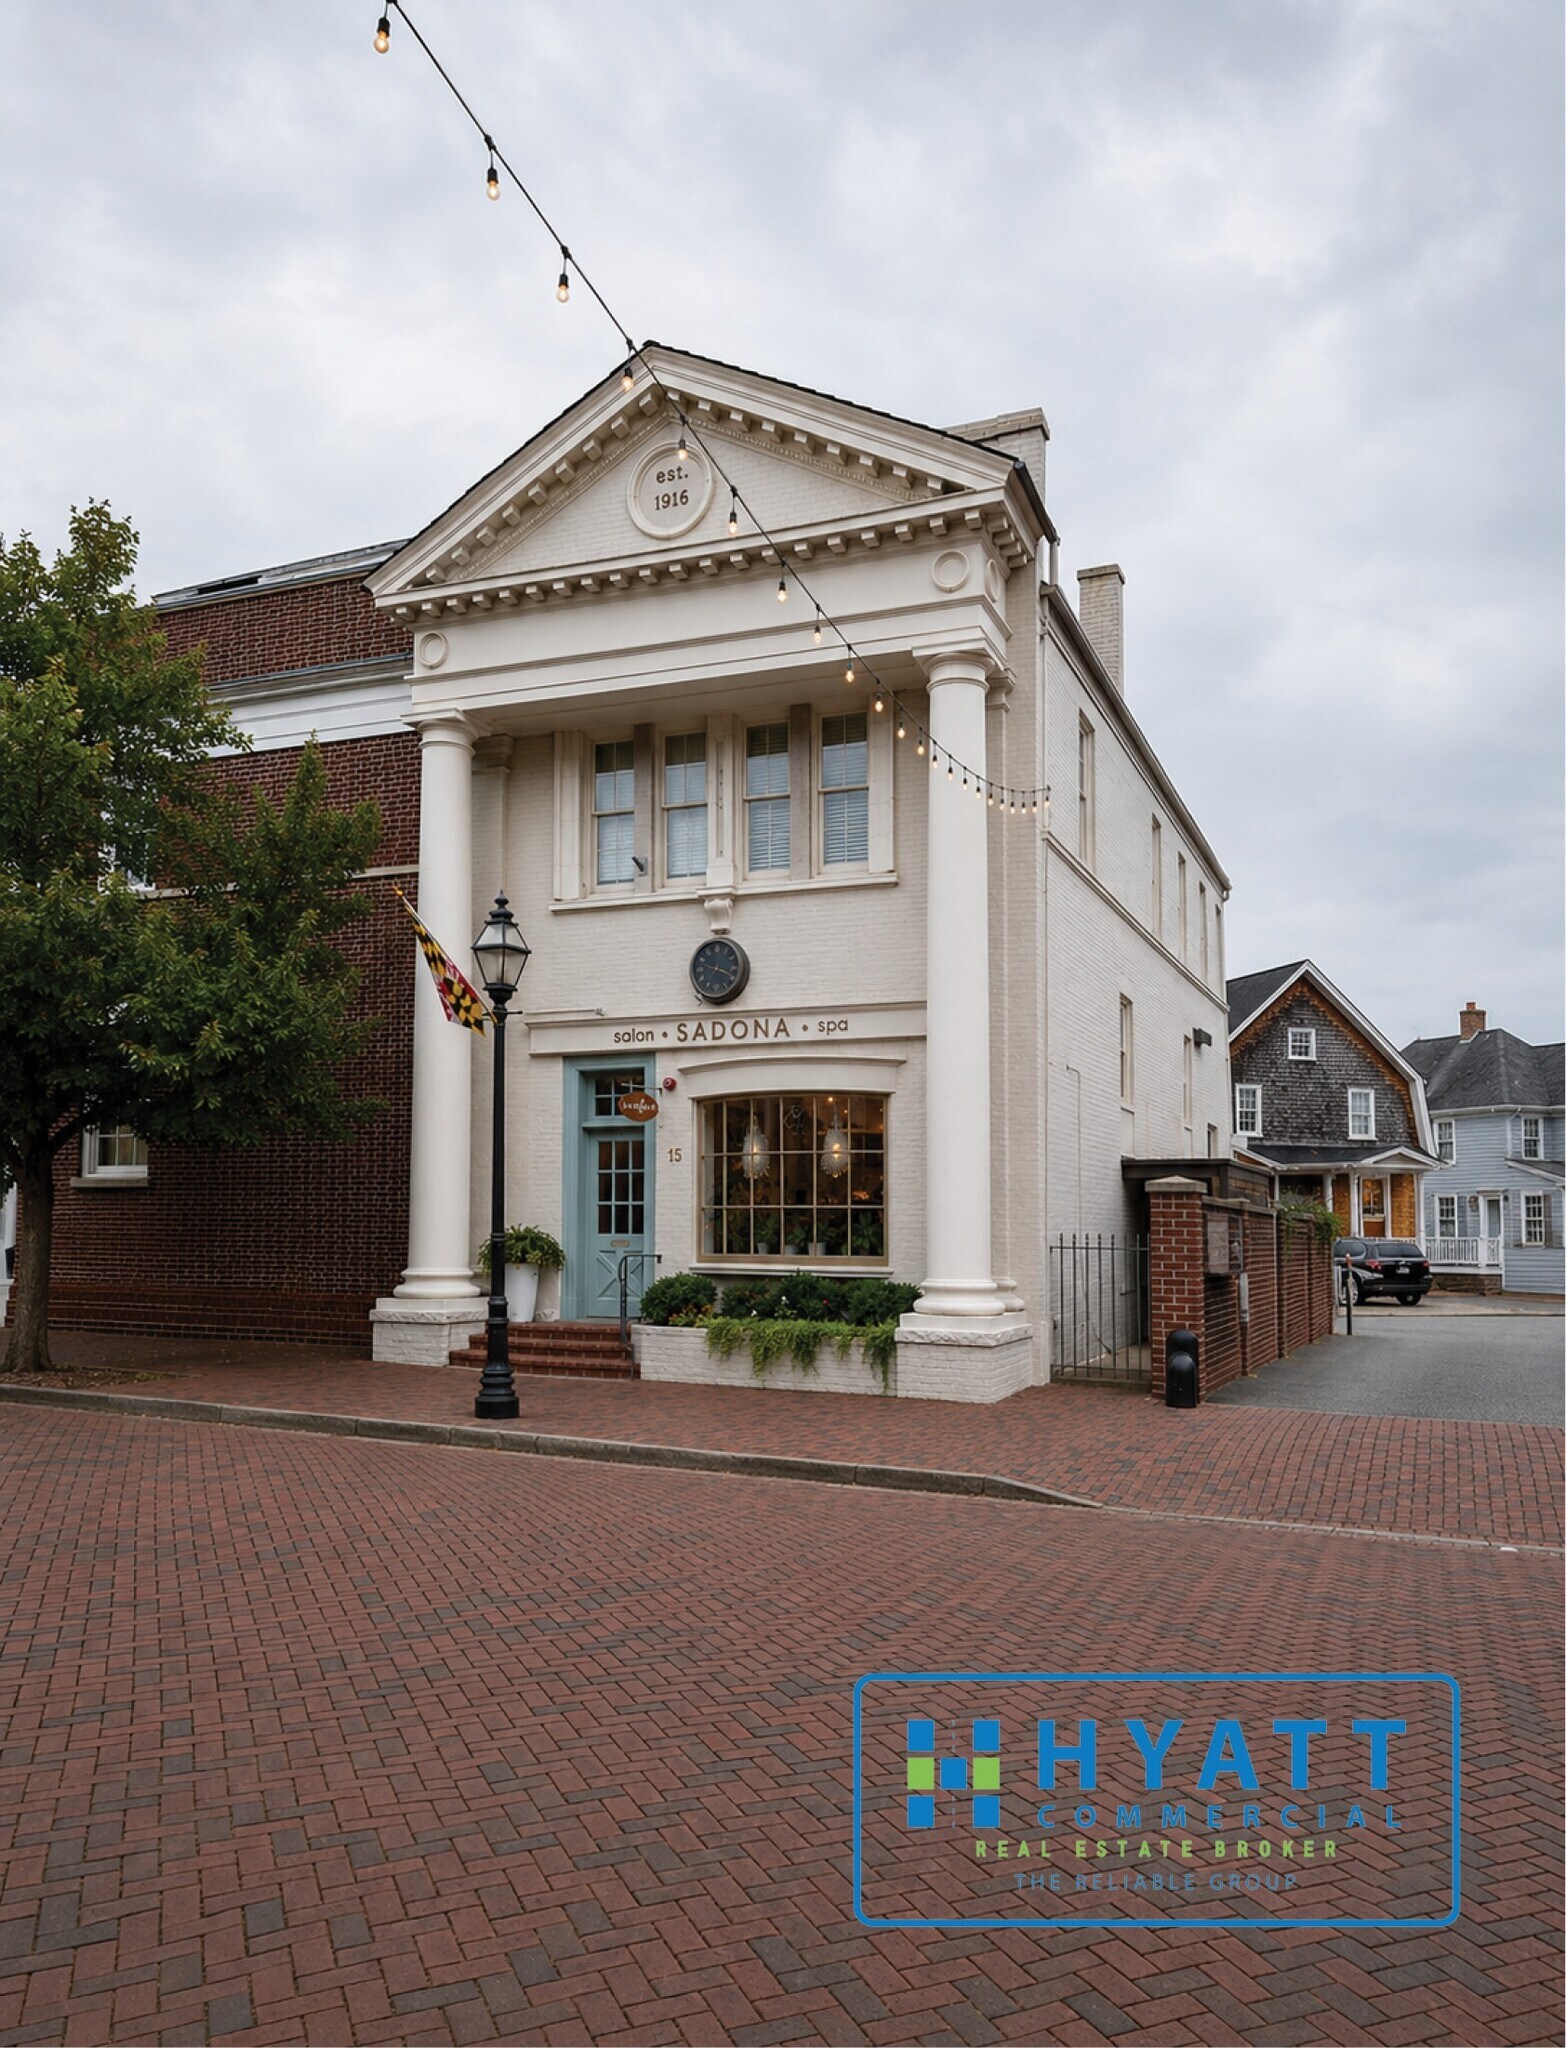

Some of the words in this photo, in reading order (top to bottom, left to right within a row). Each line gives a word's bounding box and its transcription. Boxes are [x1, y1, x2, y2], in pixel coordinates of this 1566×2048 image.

[656, 465, 689, 484] est.
[654, 489, 689, 511] 1916
[613, 1028, 655, 1044] salon
[676, 1018, 791, 1043] SADONA
[818, 1018, 849, 1036] spa
[668, 1147, 683, 1163] 15
